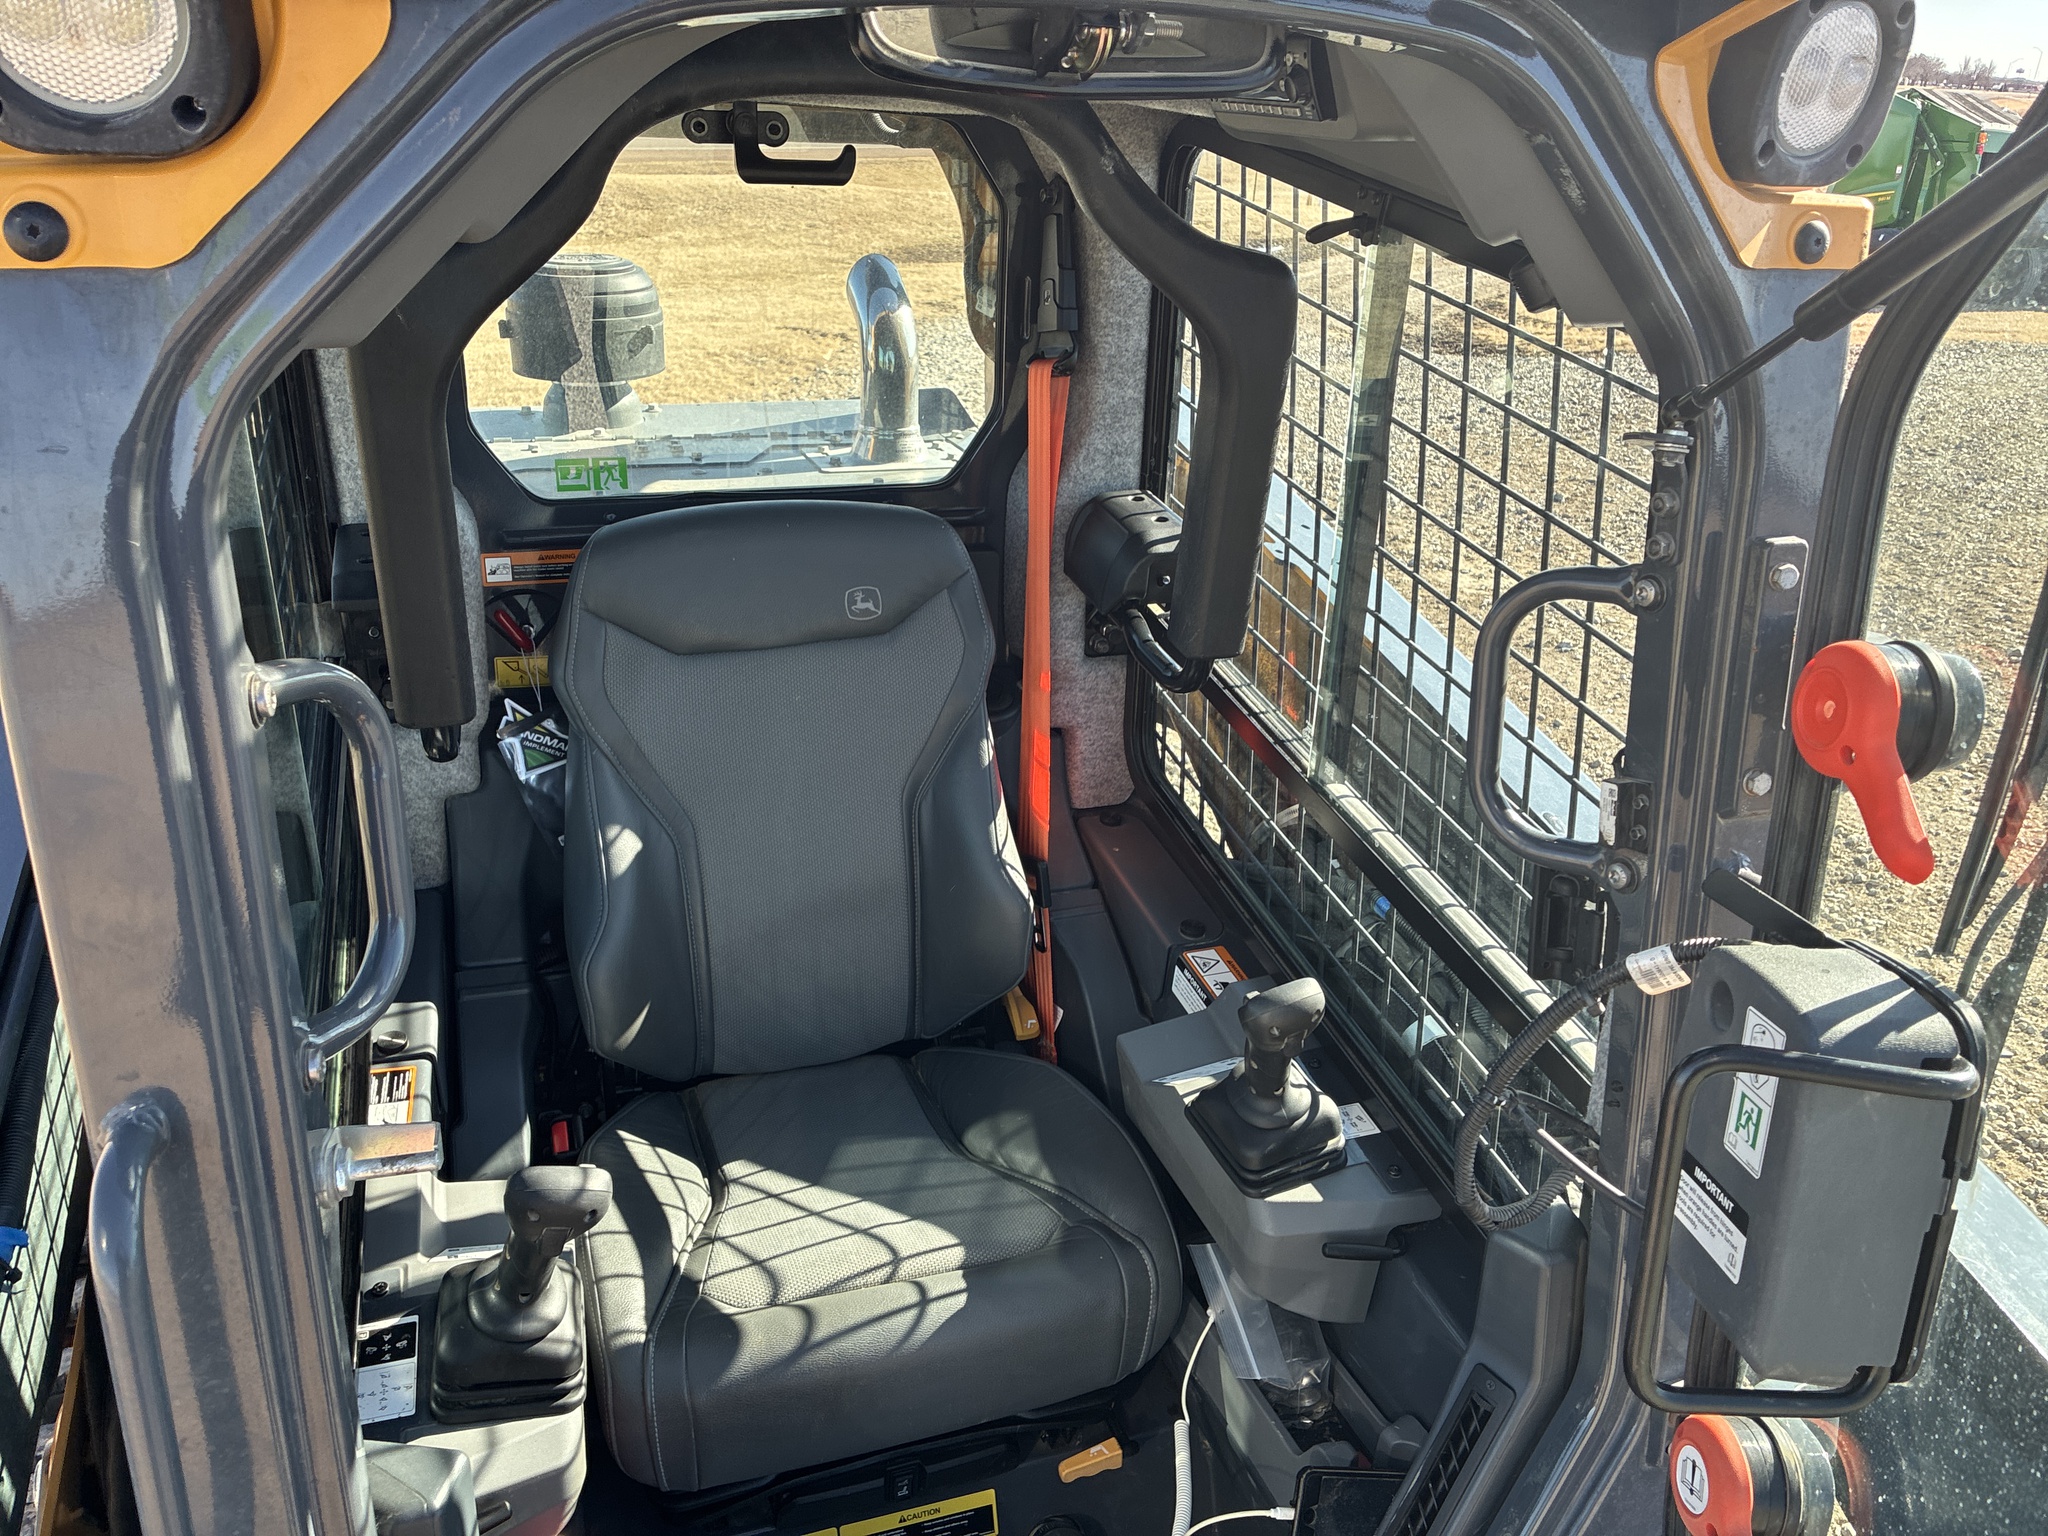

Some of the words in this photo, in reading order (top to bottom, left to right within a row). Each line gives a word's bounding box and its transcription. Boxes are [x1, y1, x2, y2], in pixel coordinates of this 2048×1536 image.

[544, 553, 576, 561] WARNING
[522, 740, 566, 758] IMPLEMENT
[1183, 968, 1207, 1002] IMPORTANT
[1693, 1165, 1735, 1214] IMPORTANT
[906, 1507, 941, 1522] CAUTION
